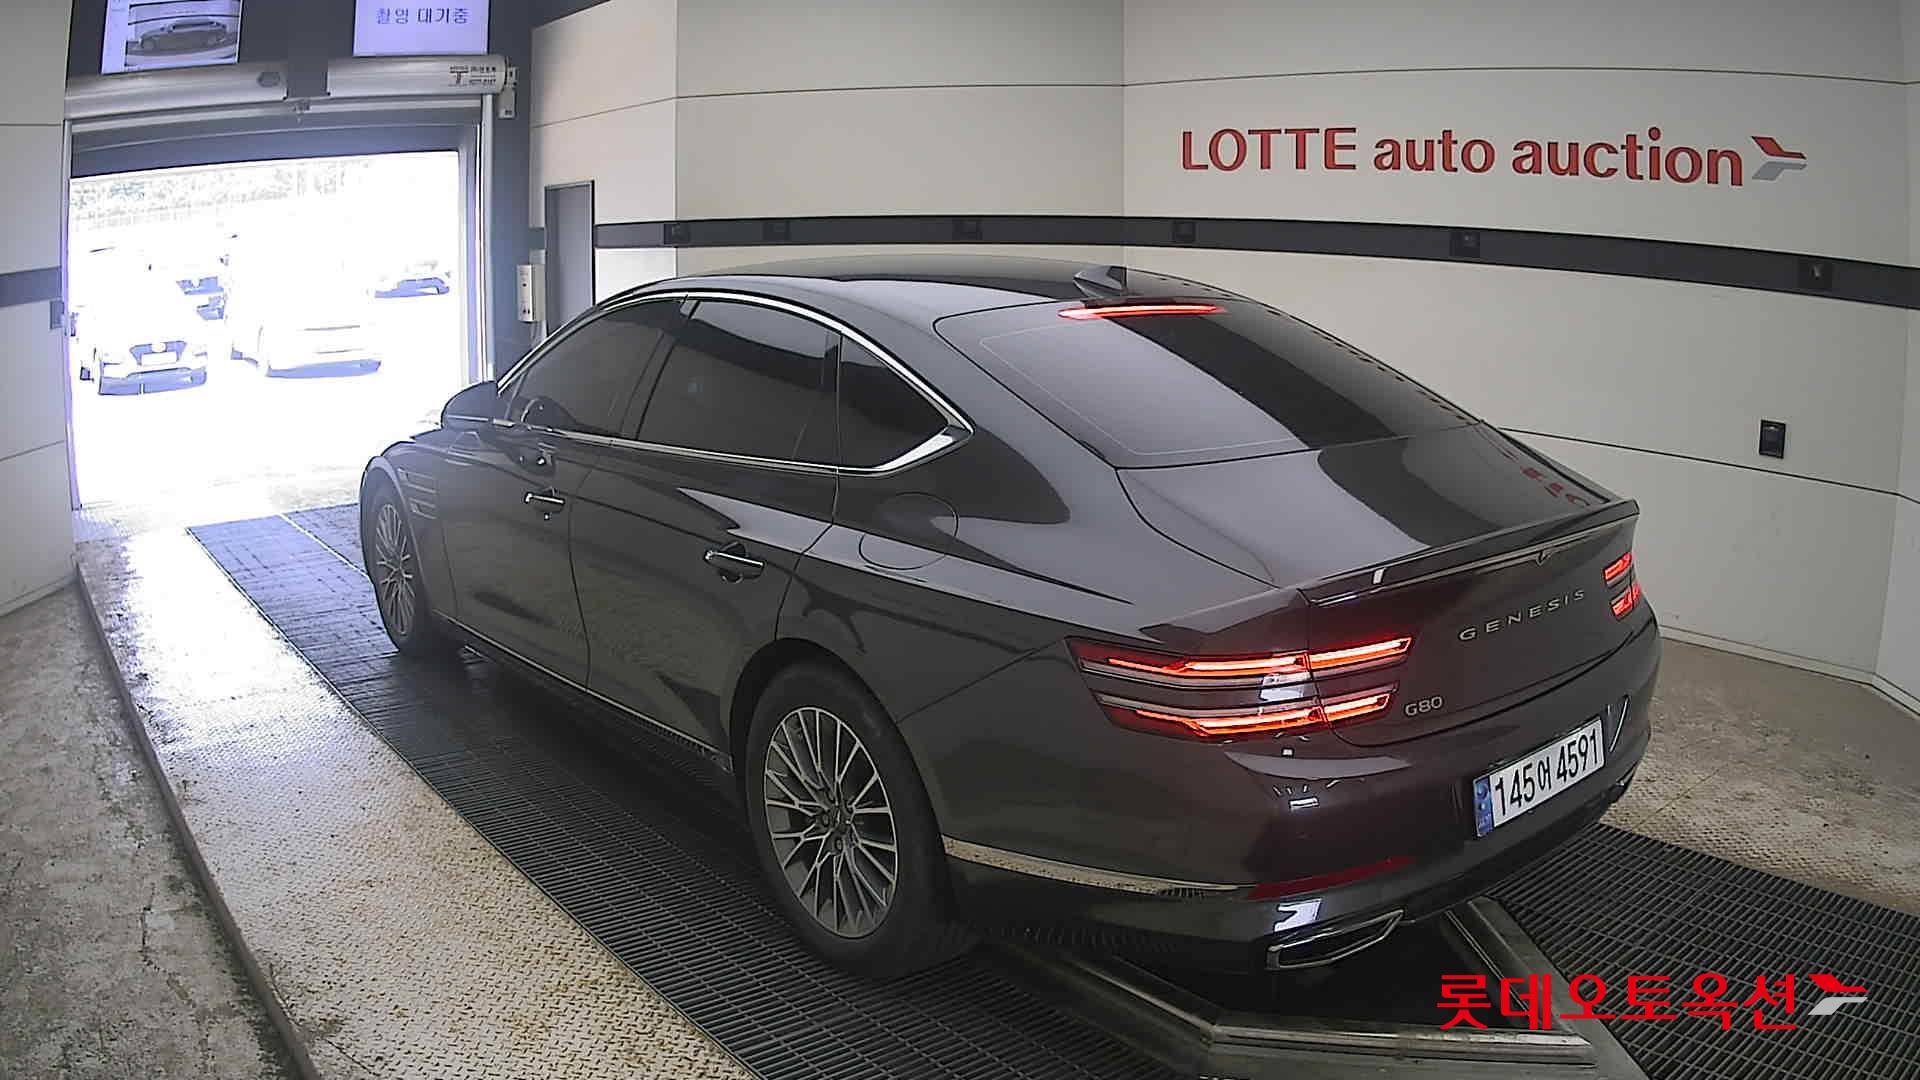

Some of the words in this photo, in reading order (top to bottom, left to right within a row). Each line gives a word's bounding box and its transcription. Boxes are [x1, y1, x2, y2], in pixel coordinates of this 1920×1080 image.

[416, 7, 470, 25] 대기중
[1181, 127, 1357, 172] LOTTE
[1373, 129, 1496, 174] auto
[1512, 126, 1743, 187] auction
[1458, 590, 1585, 641] GENESIS
[1404, 696, 1443, 717] G80
